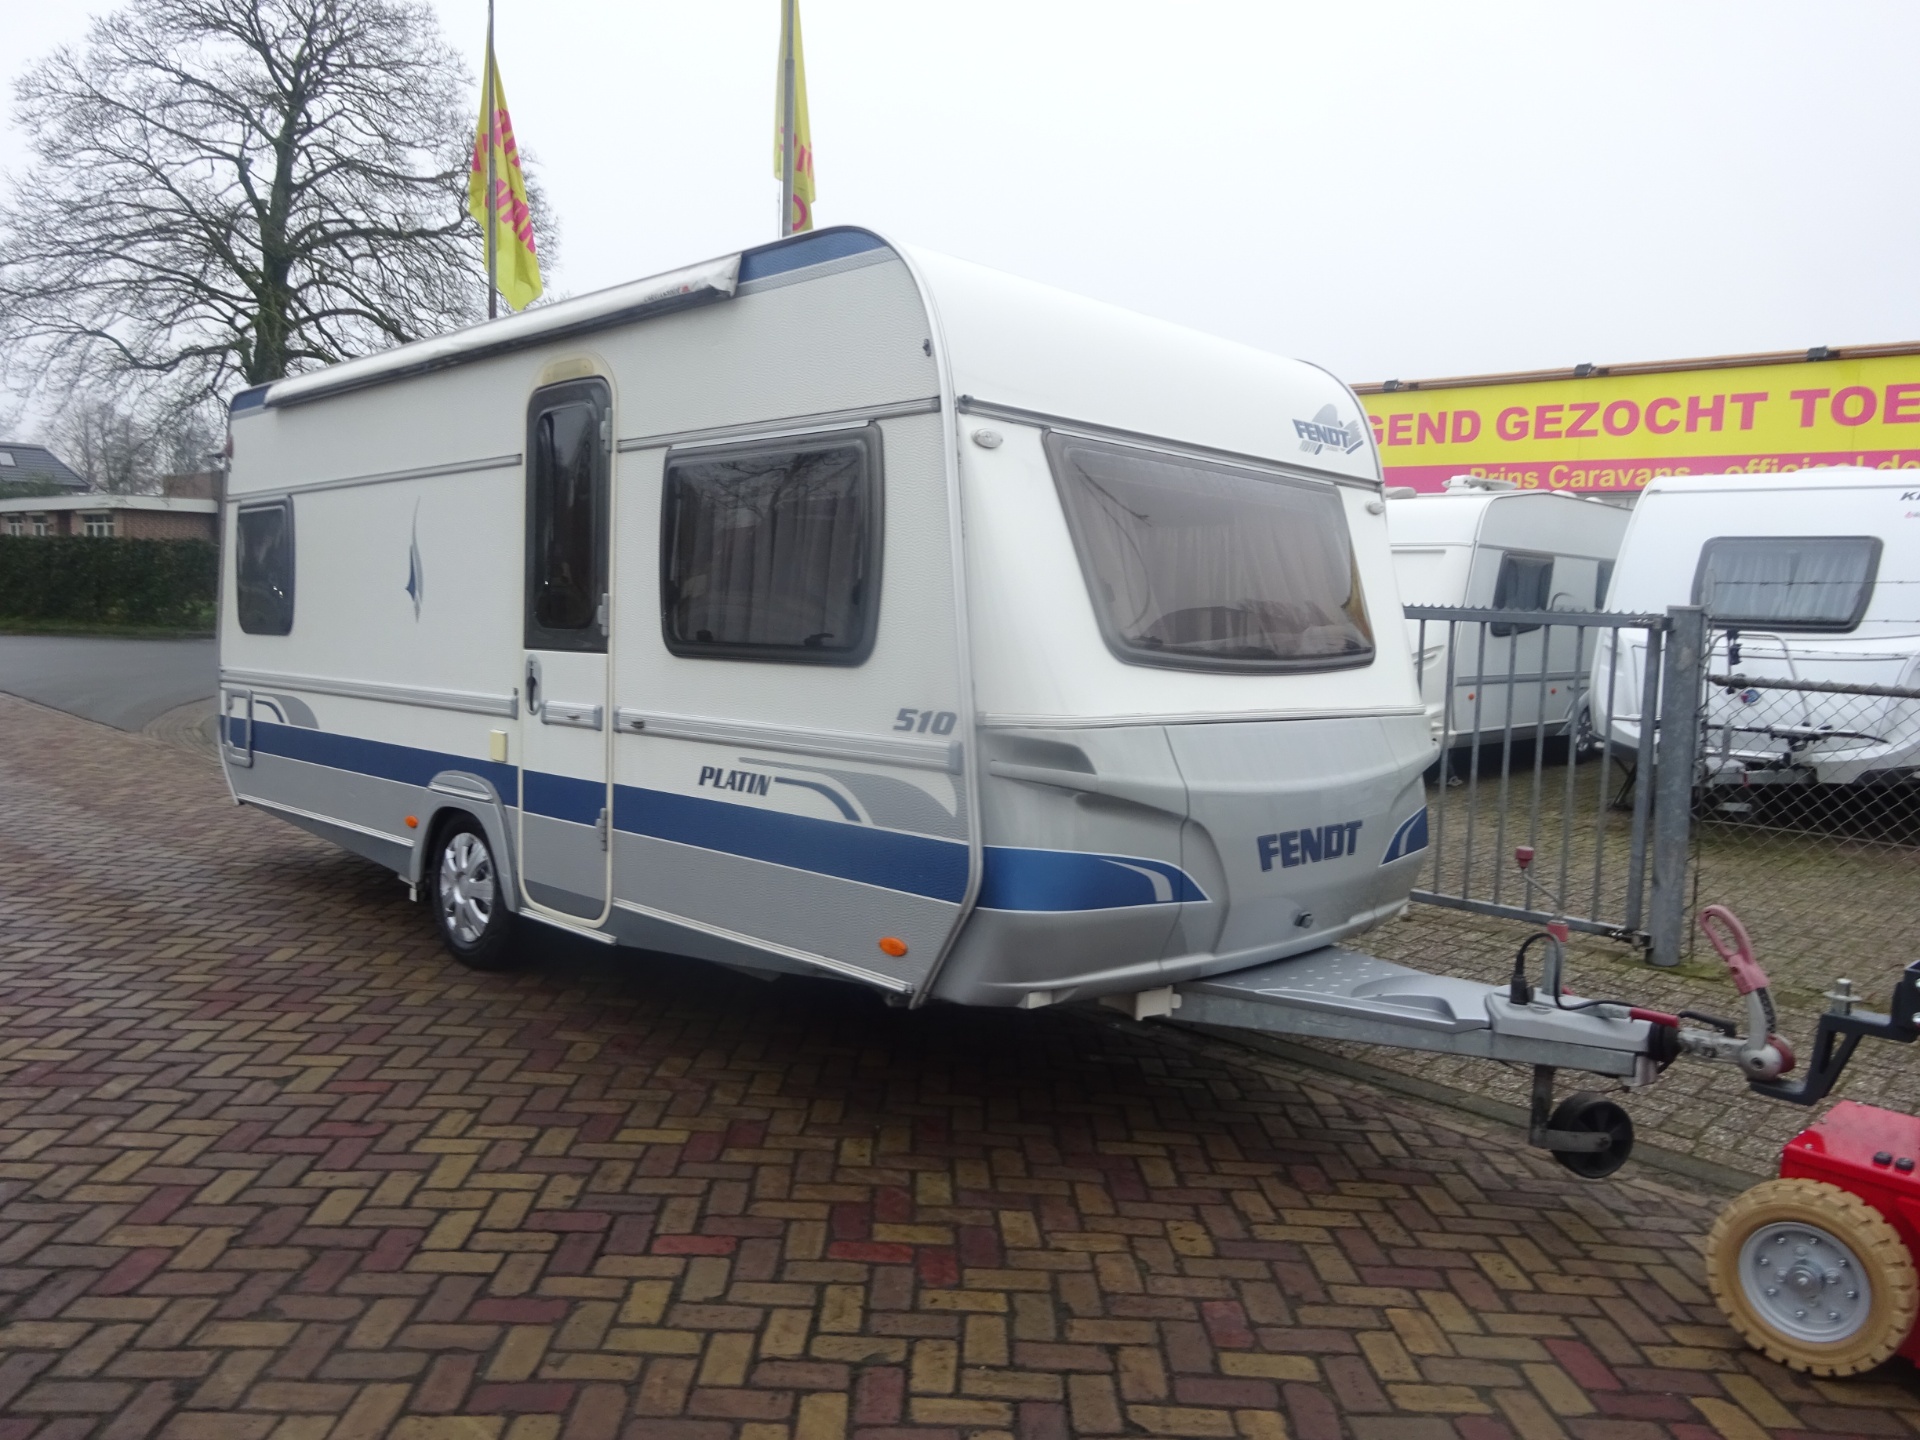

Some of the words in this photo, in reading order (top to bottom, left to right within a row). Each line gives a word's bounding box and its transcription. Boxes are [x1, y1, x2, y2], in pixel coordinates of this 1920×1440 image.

[1496, 391, 1769, 442] GEZOCHT
[1292, 418, 1350, 449] FENDT
[893, 707, 958, 736] 510
[698, 765, 772, 797] PLATIN
[1257, 819, 1364, 873] FENDT
